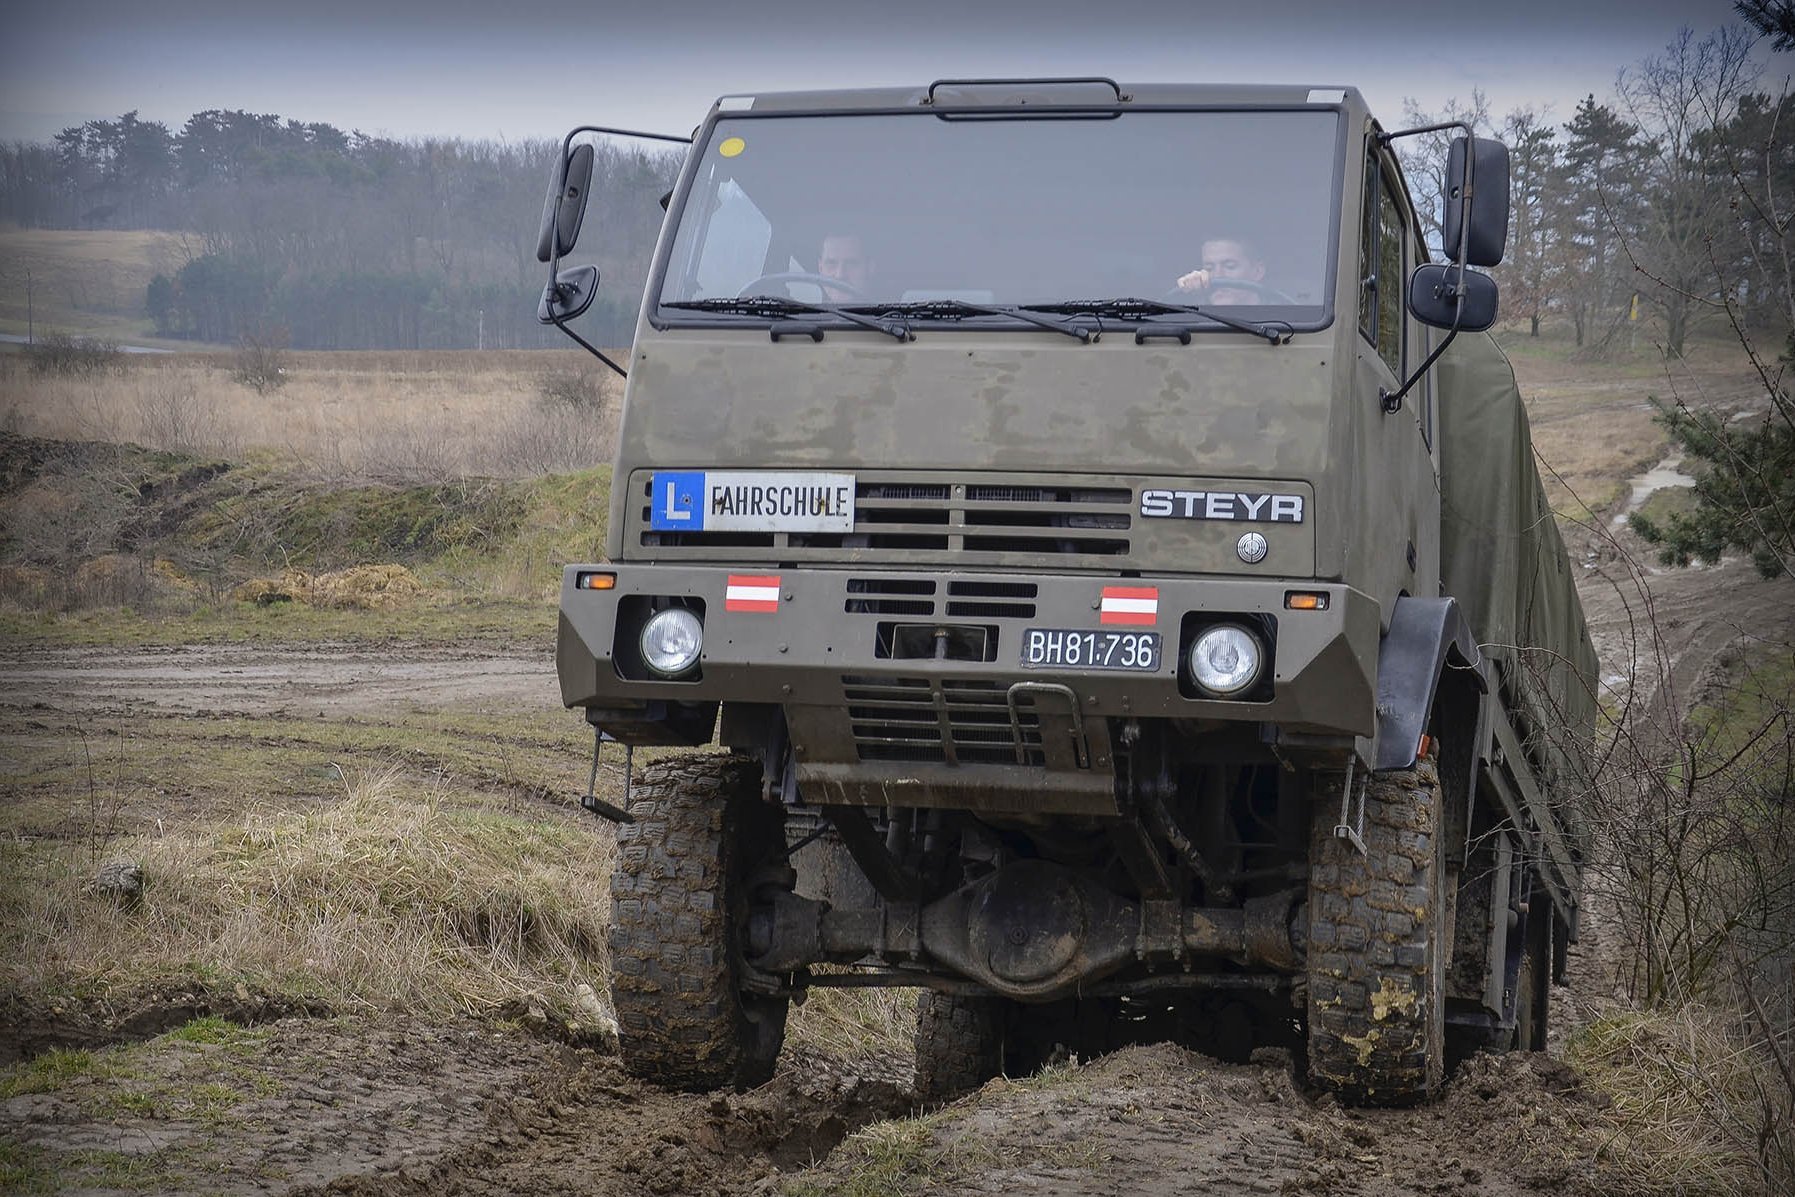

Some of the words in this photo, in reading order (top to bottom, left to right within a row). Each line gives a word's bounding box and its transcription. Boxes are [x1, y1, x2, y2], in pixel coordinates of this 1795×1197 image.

[666, 482, 691, 520] L
[711, 486, 848, 517] FAHRSCHULE
[1141, 490, 1303, 522] STEYR
